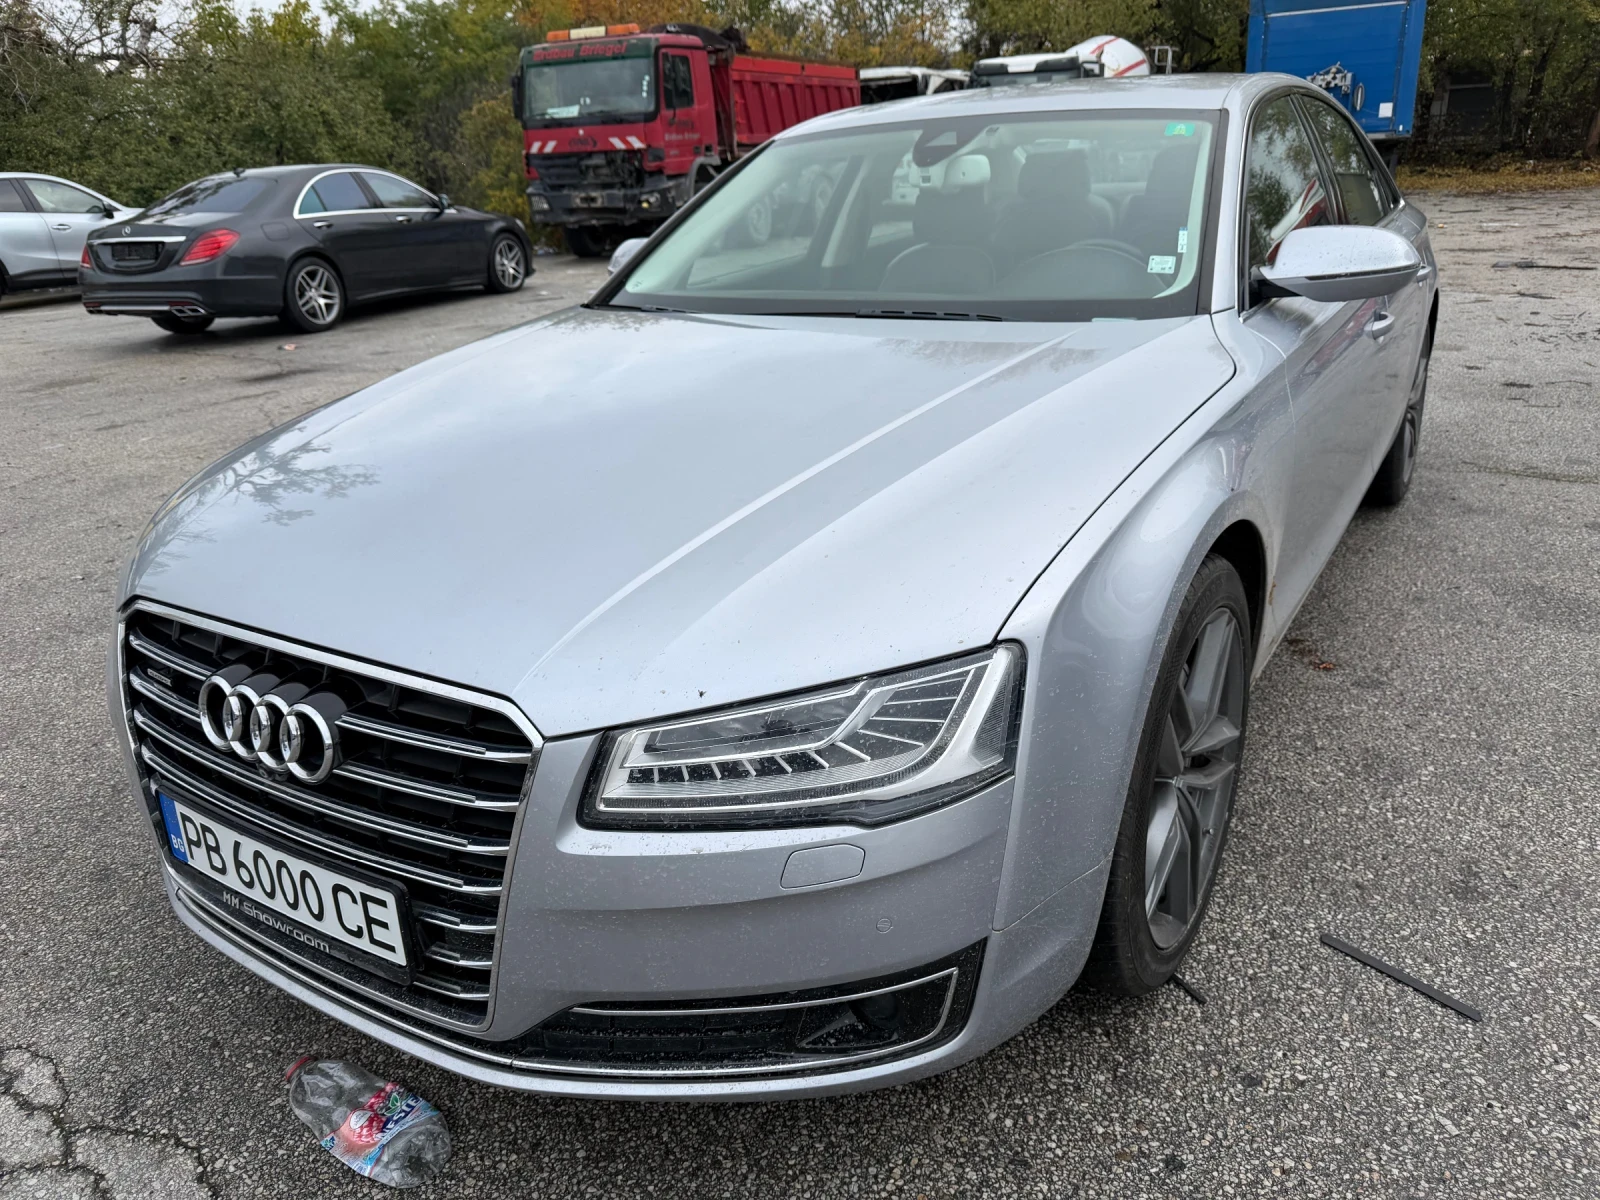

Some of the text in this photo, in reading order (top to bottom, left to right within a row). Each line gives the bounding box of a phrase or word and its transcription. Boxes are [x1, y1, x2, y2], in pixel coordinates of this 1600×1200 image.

[171, 834, 184, 852] BG
[223, 891, 329, 953] MM Showroom
[233, 840, 324, 921] 6000
[332, 883, 396, 953] CE
